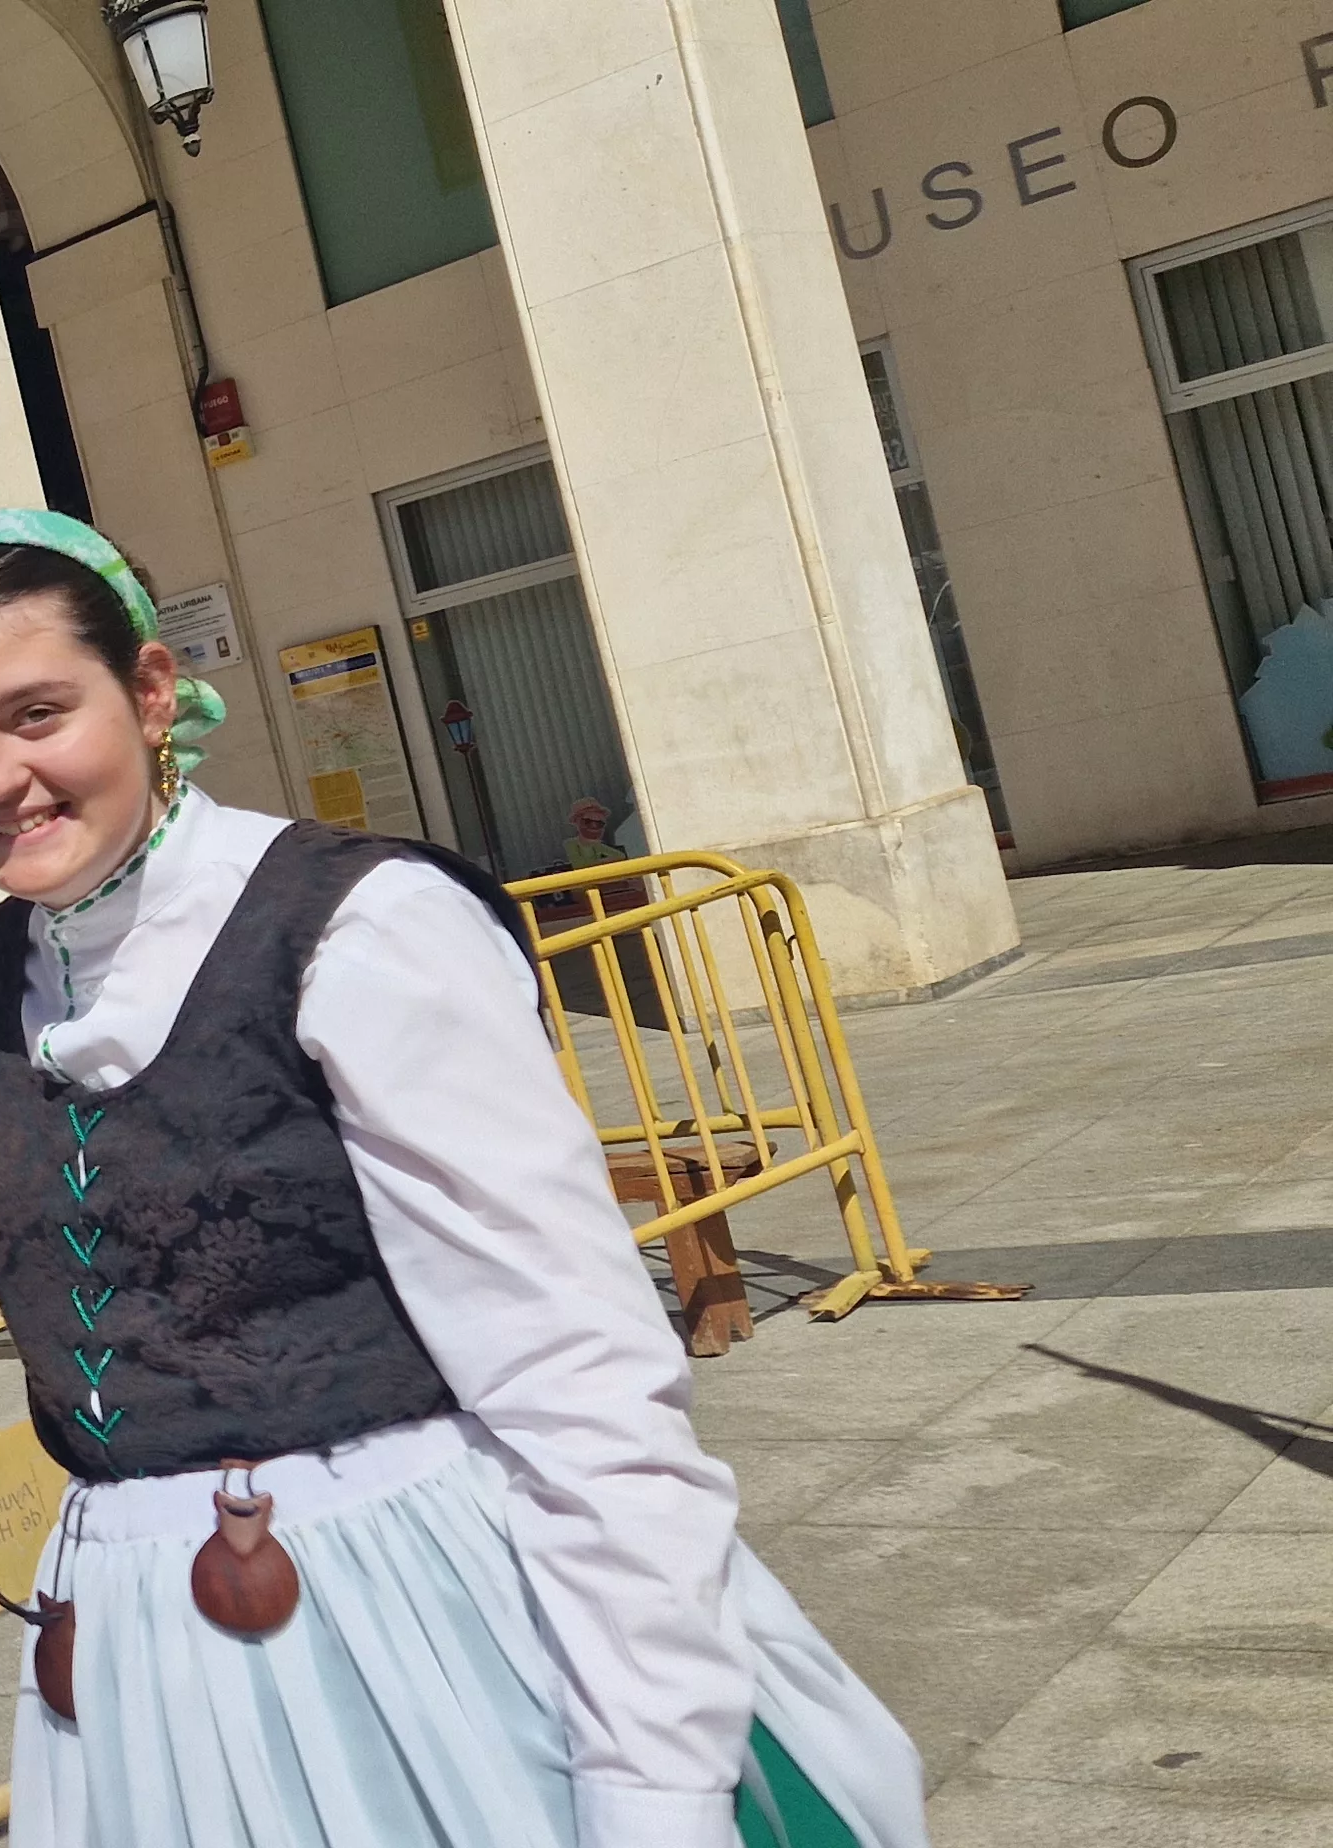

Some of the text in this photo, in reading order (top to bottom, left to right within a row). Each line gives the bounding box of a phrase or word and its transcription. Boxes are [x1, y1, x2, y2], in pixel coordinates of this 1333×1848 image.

[831, 95, 1178, 262] USEO
[157, 594, 213, 616] ATIVA URBANA
